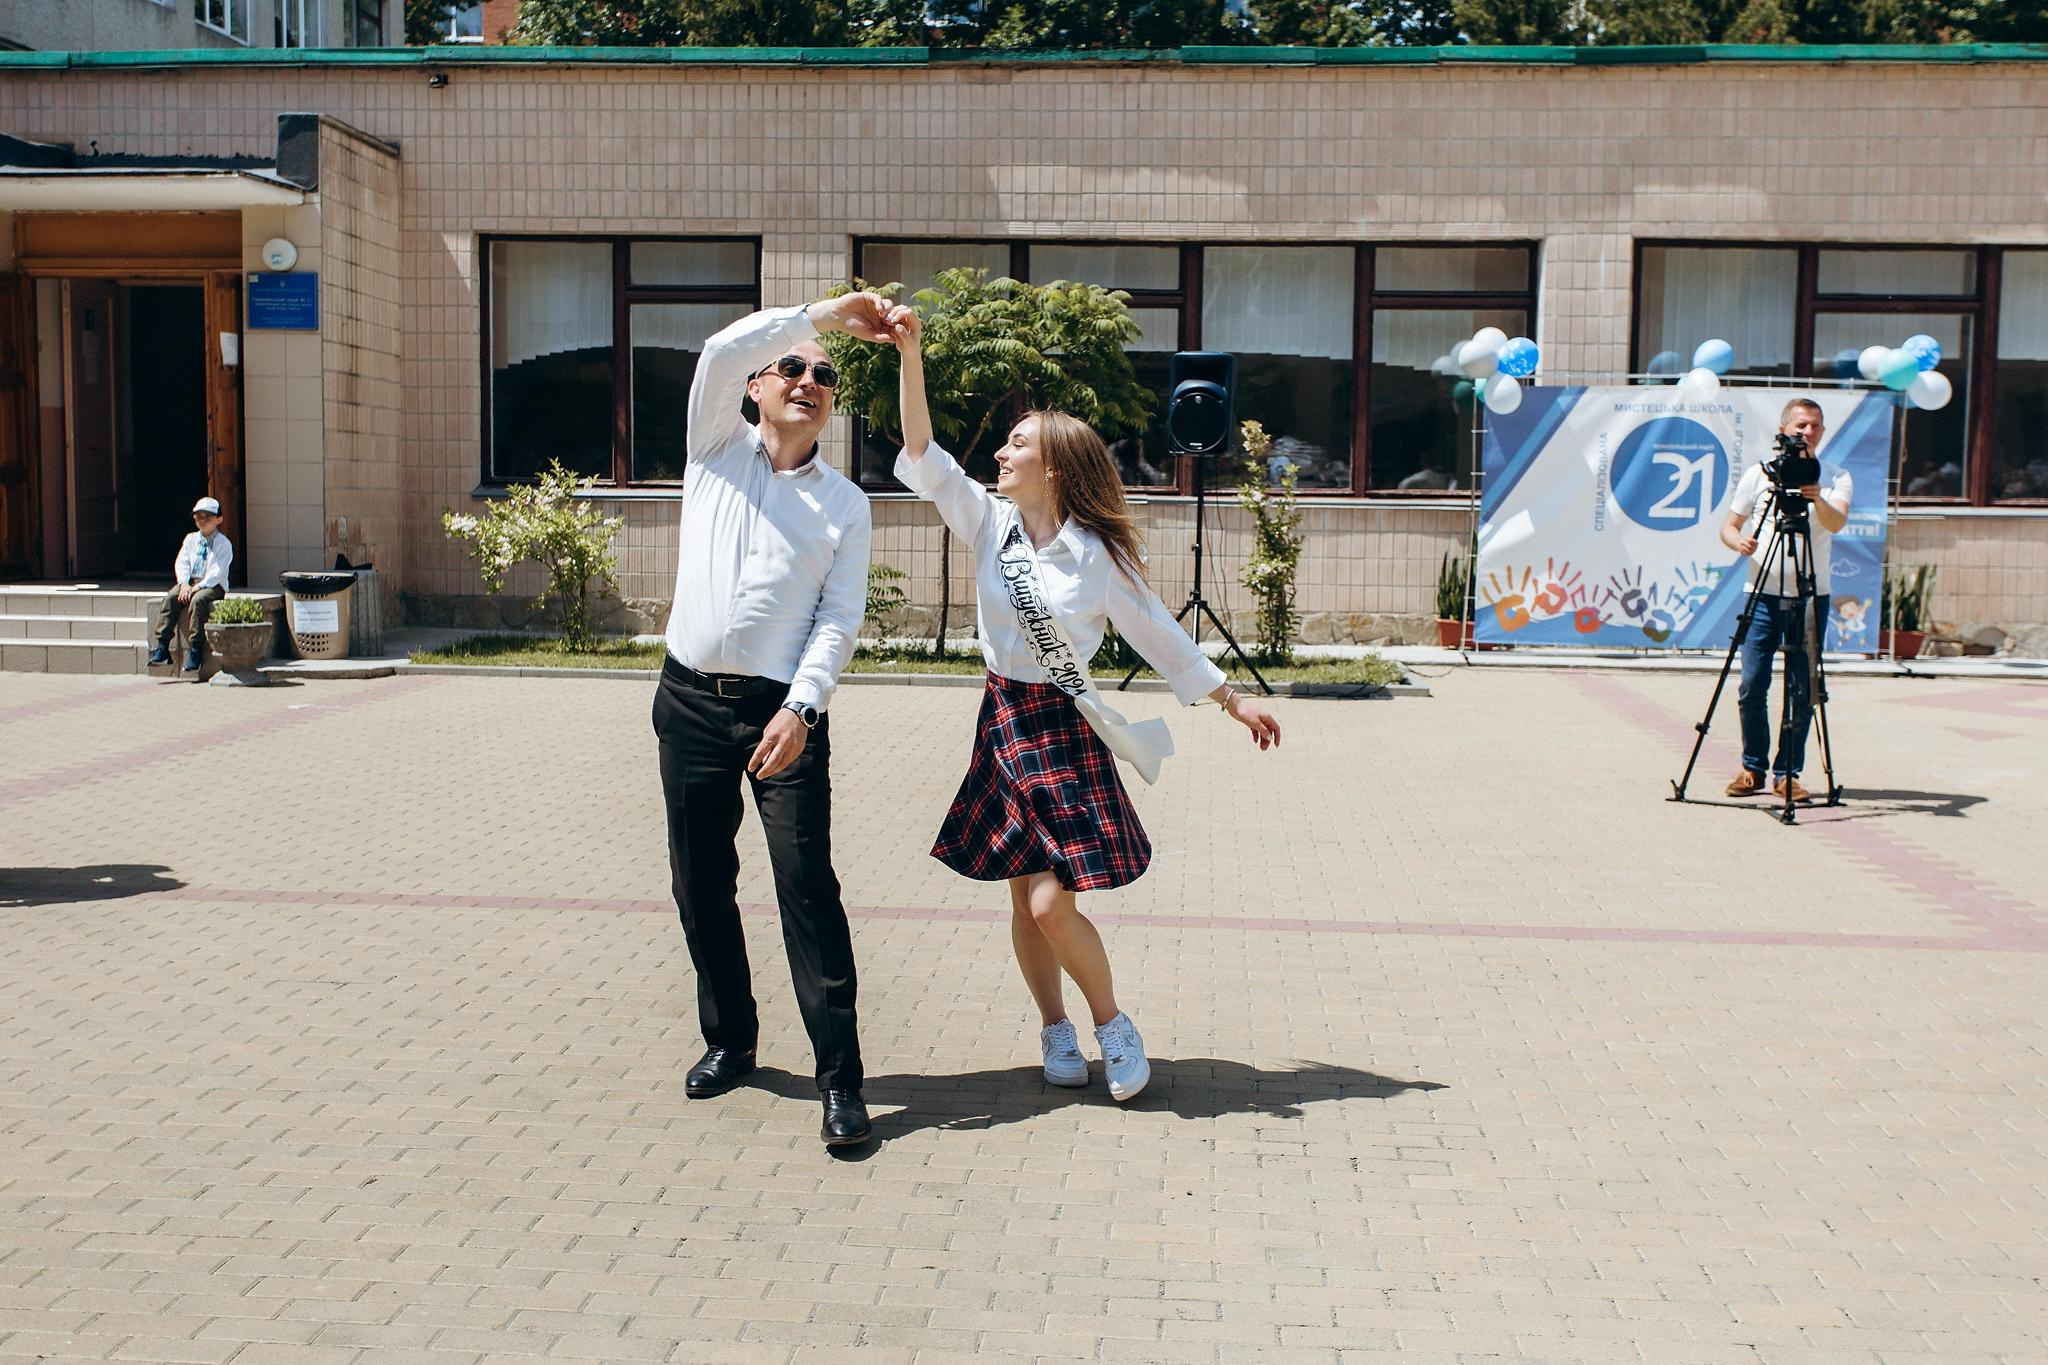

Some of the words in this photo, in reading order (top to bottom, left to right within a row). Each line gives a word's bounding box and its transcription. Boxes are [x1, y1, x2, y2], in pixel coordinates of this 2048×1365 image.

[1614, 403, 1686, 414] МИСТЕЦЬКА
[1689, 404, 1734, 414] ШКОЛА
[1594, 432, 1608, 533] СПЕЦІАЛІЗОВАНА
[1648, 451, 1716, 524] 21
[998, 542, 1067, 668] Випускник
[1048, 661, 1088, 696] 2021
